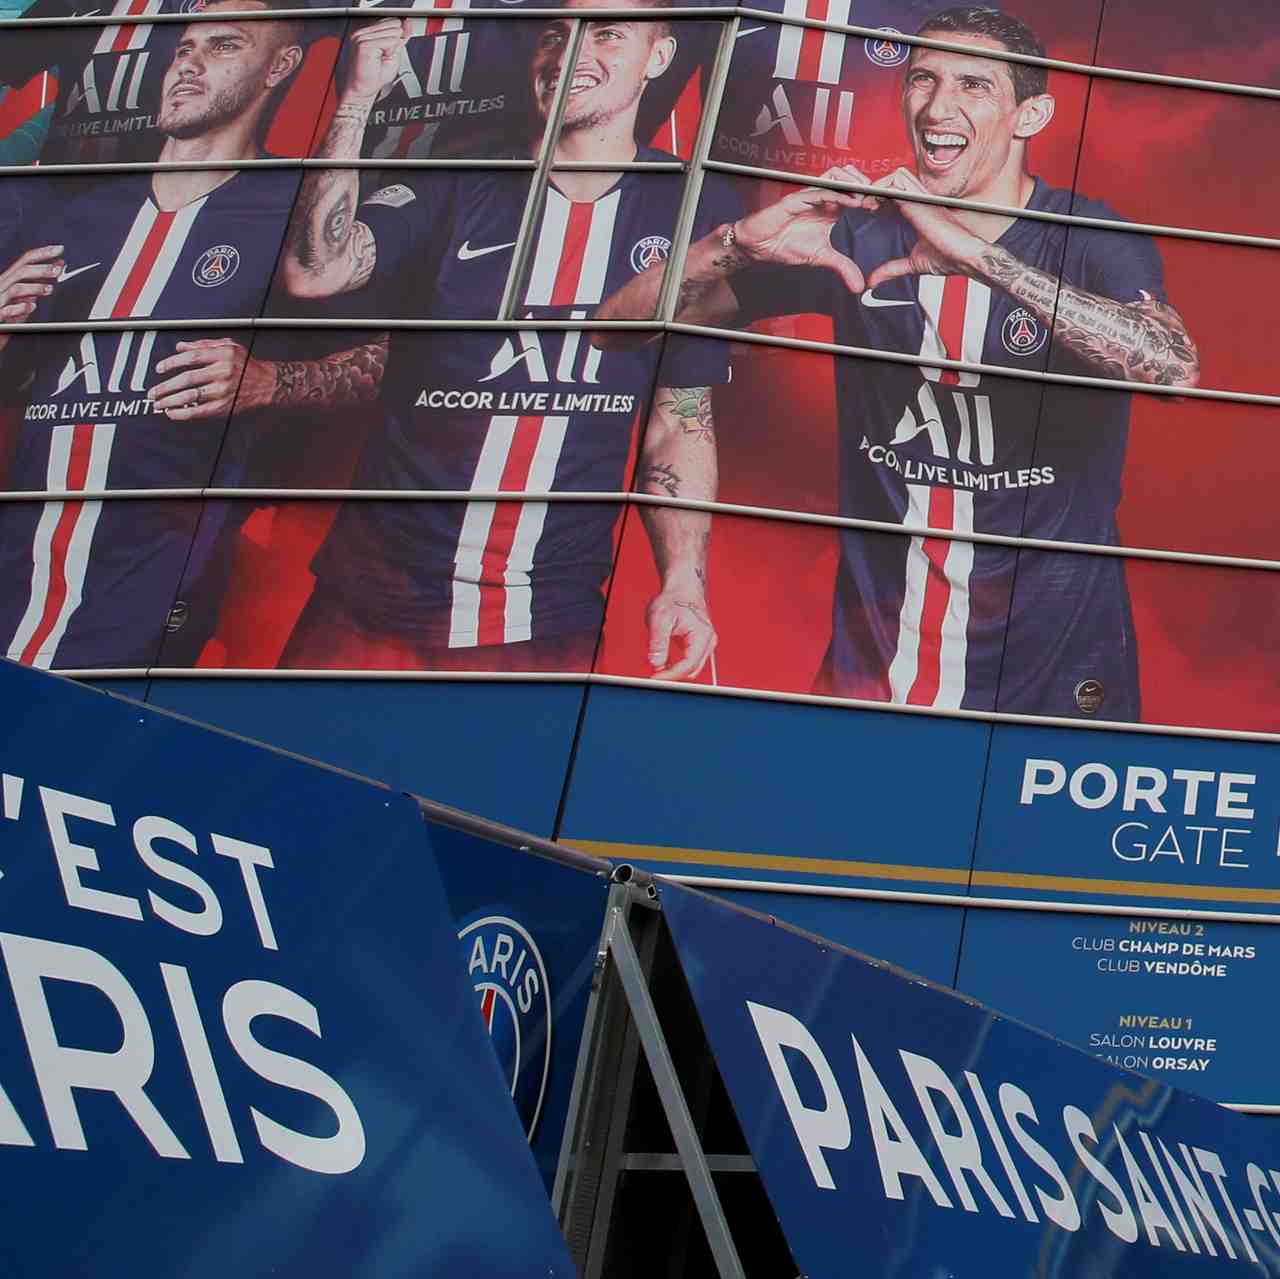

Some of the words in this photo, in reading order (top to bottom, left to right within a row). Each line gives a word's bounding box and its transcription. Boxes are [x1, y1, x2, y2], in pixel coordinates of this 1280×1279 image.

[424, 95, 505, 118] LIMITLESS
[61, 401, 101, 419] LIVE
[415, 389, 493, 410] ACCOR
[497, 391, 548, 411] LIVE
[552, 393, 635, 413] LIMITLESS
[904, 459, 949, 484] LIVE
[952, 466, 1056, 491] LIMITLESS
[1018, 758, 1257, 821] PORTE
[1110, 822, 1252, 868] GATE
[0, 773, 279, 951] 'EST
[1129, 922, 1191, 936] NIVEAU
[1195, 924, 1204, 937] 2
[1071, 936, 1115, 952] CLUB
[1118, 939, 1178, 955] CHAMP
[1182, 943, 1205, 956] DE
[1208, 945, 1256, 959] MARS
[468, 933, 539, 1014] ARIS
[1097, 958, 1141, 973] CLUB
[1144, 960, 1228, 977] VENDÔME
[1119, 1016, 1182, 1030] NIVEAU
[1185, 1018, 1193, 1030] 1
[0, 931, 366, 1175] RIS
[1089, 1033, 1145, 1049] SALON
[1149, 1036, 1217, 1052] LOUVRE
[1152, 1056, 1211, 1071] ORSAY
[745, 999, 1082, 1234] PARIS
